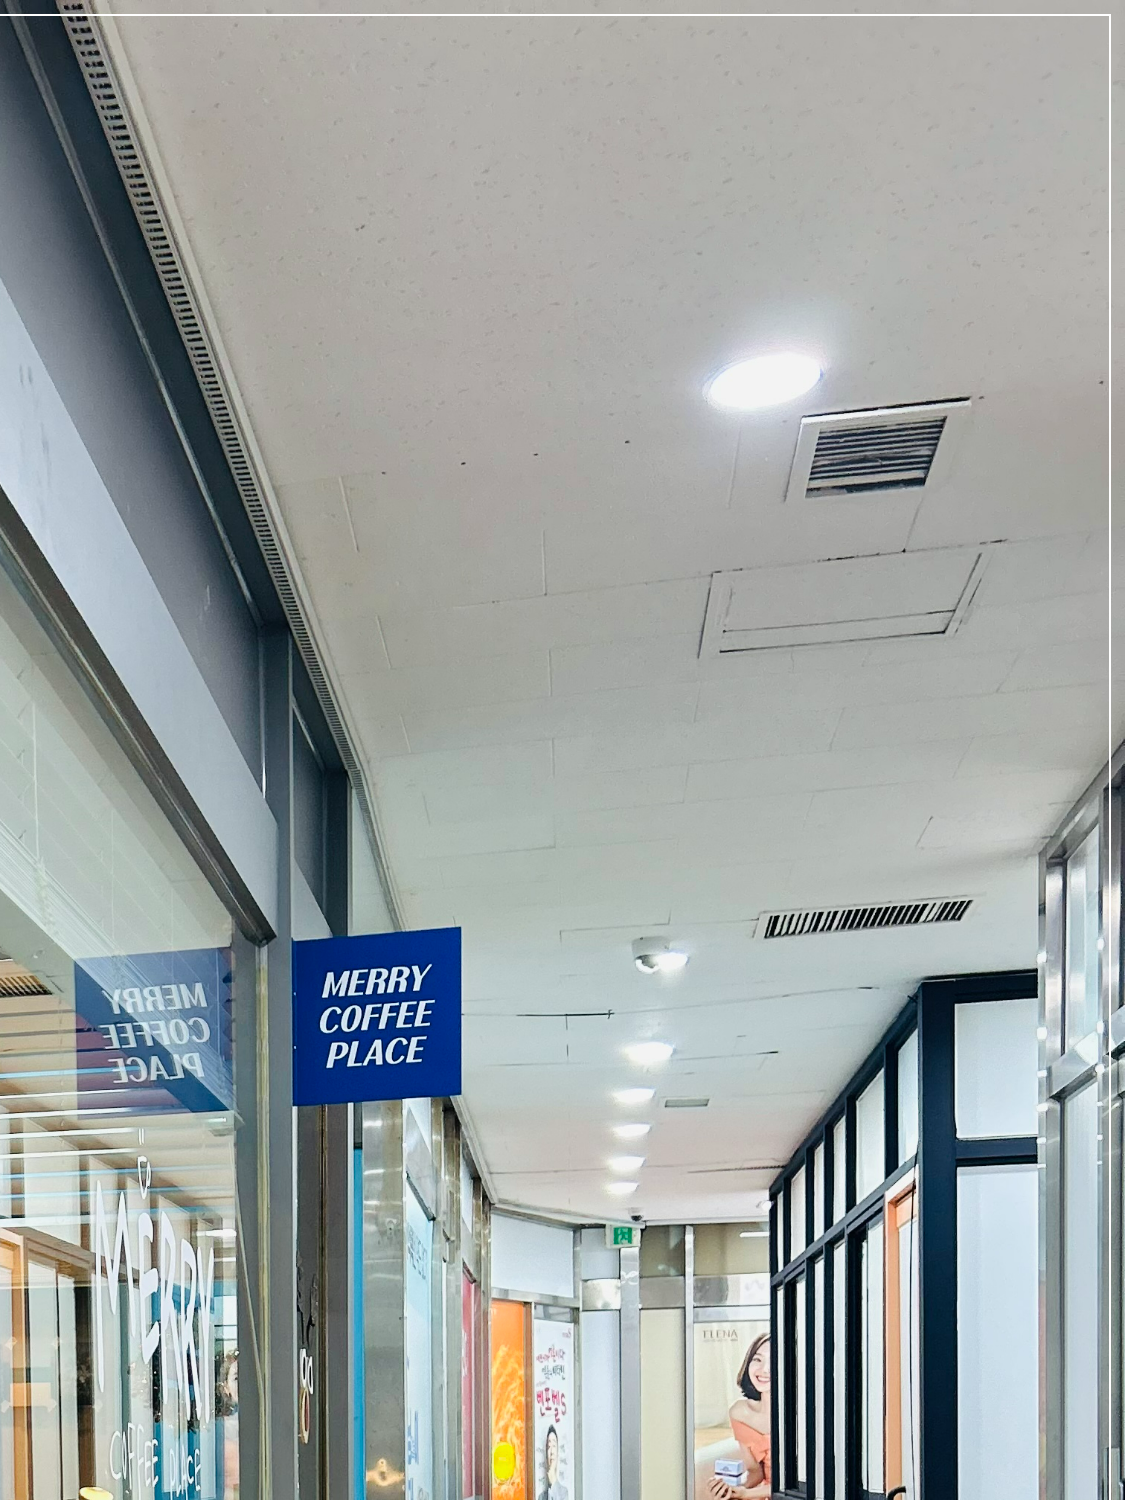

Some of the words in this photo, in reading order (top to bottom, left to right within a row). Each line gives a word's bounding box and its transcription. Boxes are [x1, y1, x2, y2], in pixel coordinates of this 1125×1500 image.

[321, 963, 432, 998] MERRY
[319, 999, 435, 1034] COFFEE
[326, 1036, 427, 1069] PLACE
[95, 1179, 215, 1424] MERRY
[702, 1329, 739, 1339] ELENA
